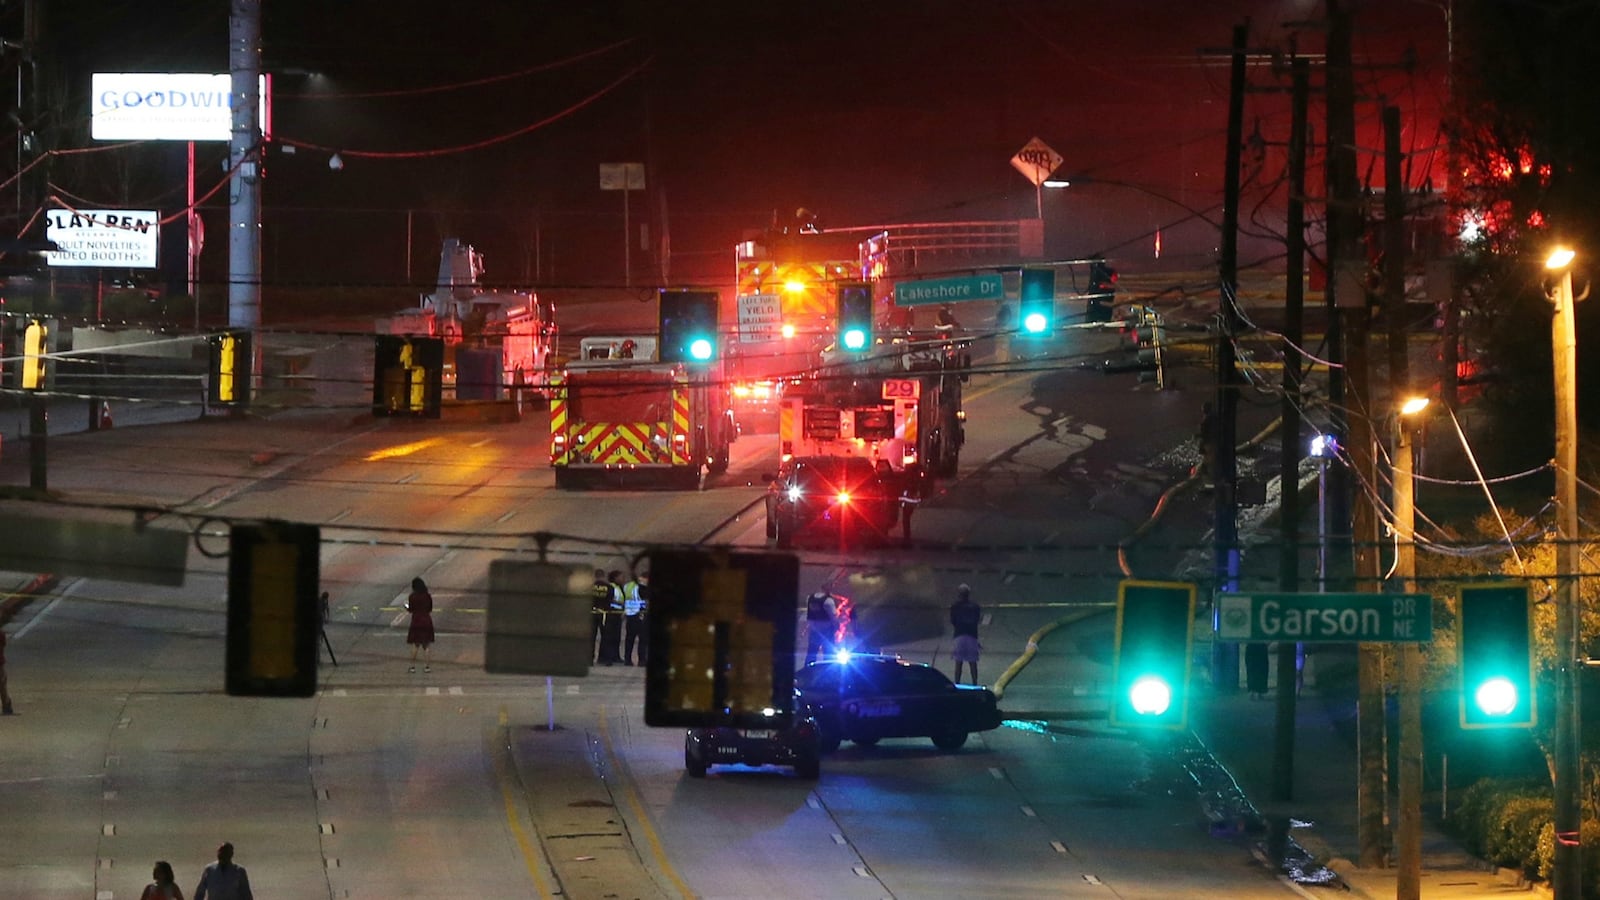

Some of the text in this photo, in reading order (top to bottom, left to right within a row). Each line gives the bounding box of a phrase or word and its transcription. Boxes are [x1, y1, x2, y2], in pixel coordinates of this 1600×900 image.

[105, 214, 151, 234] PEN
[57, 240, 140, 250] DULT NOVELTIES
[51, 251, 141, 261] VIDEO BOOTHS
[899, 280, 997, 301] Lakeshore Dr
[746, 306, 774, 315] YIELD
[885, 381, 914, 397] 29
[1259, 598, 1416, 636] Garson DR
[1392, 619, 1415, 638] NE
